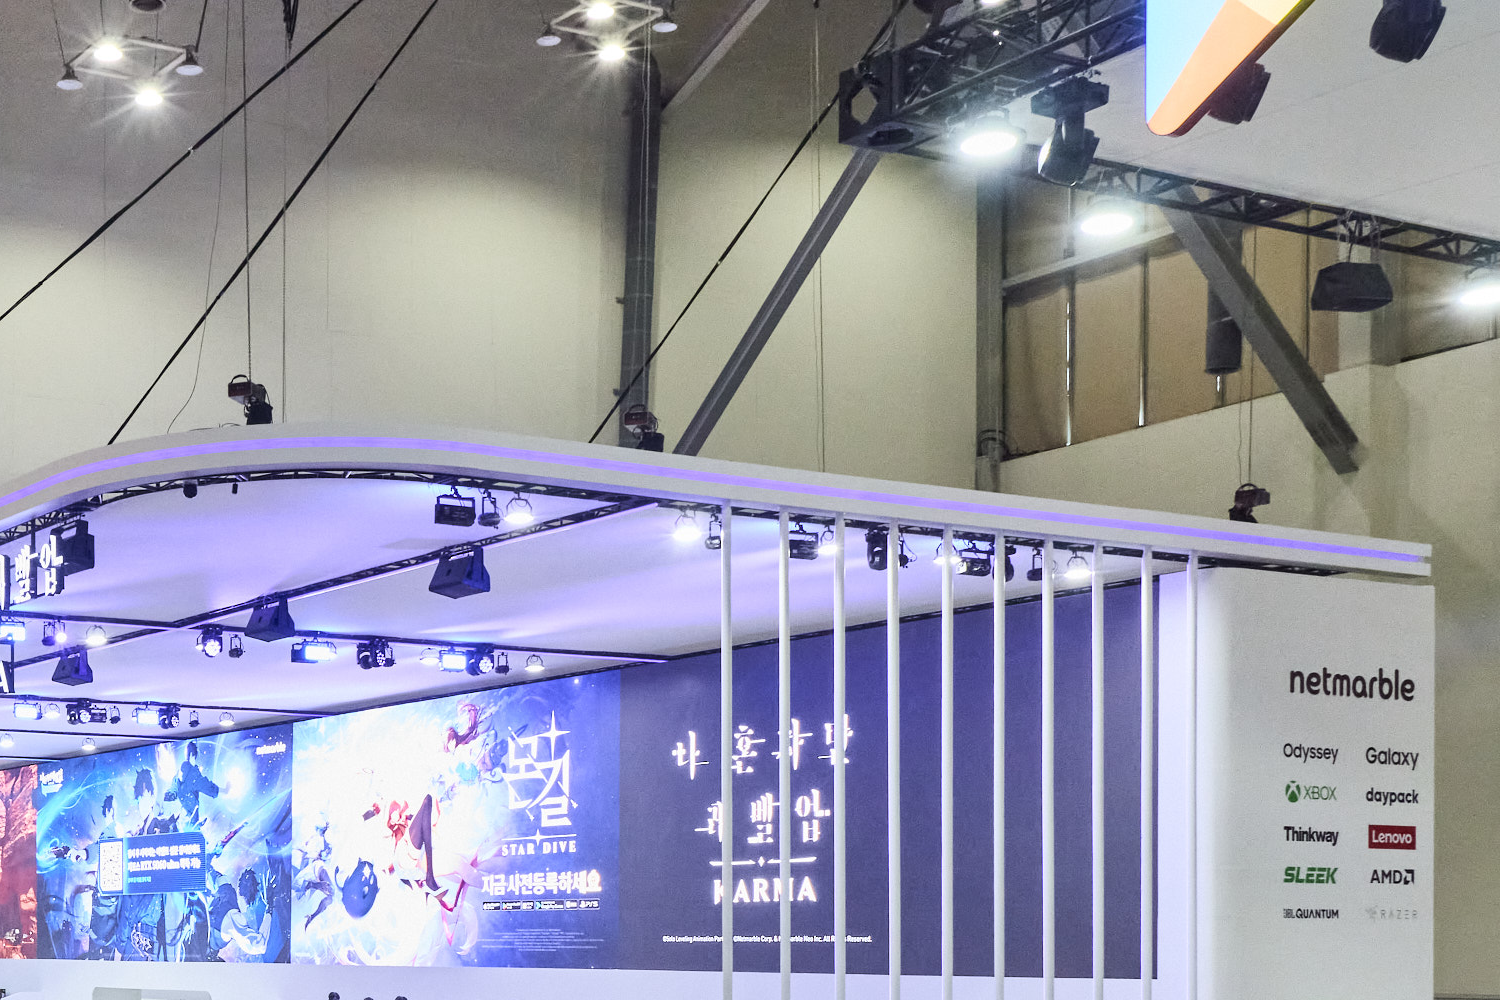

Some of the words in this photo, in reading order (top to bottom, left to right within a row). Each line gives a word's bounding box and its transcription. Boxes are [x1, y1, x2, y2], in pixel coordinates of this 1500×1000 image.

[1289, 667, 1415, 701] netmarble
[1283, 743, 1339, 764] Odyssey
[1365, 747, 1419, 770] Galaxy
[1303, 785, 1337, 800] XBOX
[1366, 787, 1419, 806] daypack
[1283, 826, 1339, 846] Thinkway
[1371, 830, 1413, 845] Lenovo
[502, 842, 536, 857] STAR
[542, 840, 577, 854] DIVE
[481, 873, 506, 896] 지금
[507, 868, 603, 896] 사전등록하세요
[1283, 866, 1338, 884] SLEEK
[1370, 870, 1403, 885] AMD
[1380, 909, 1418, 920] RAZER
